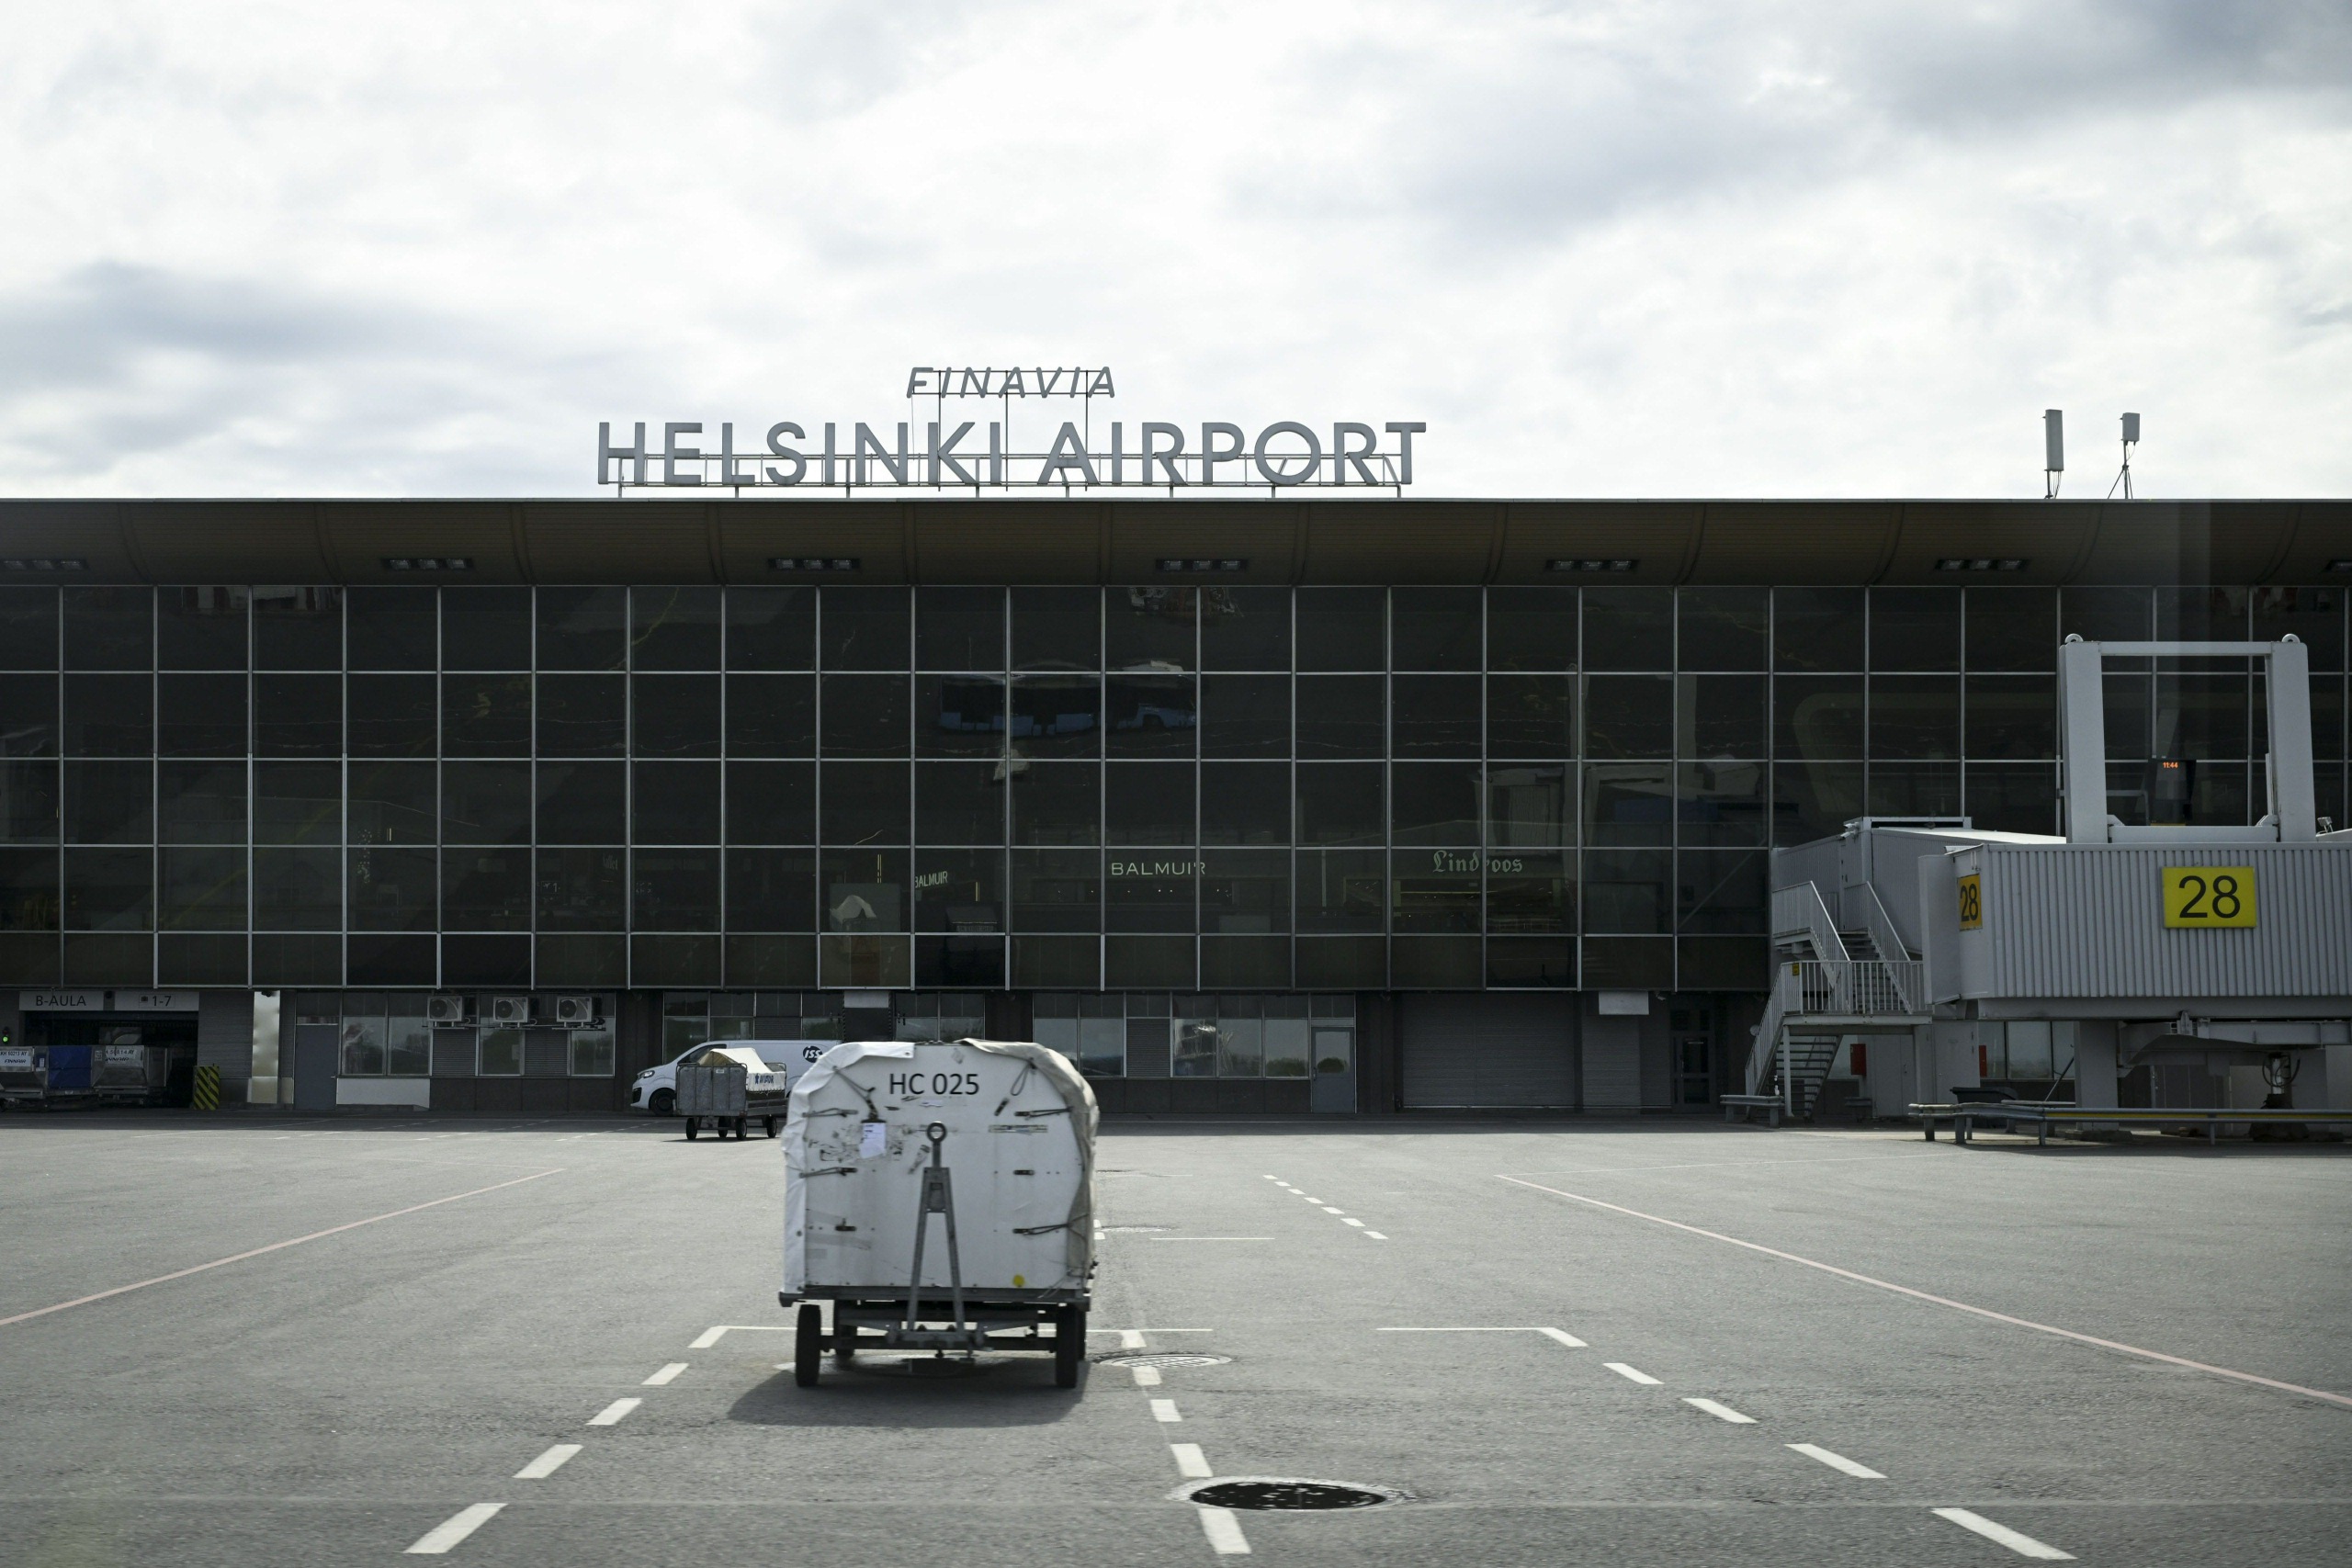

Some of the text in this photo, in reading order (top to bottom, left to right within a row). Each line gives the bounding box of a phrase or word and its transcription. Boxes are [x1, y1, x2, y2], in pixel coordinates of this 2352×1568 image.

[906, 367, 1115, 399] FINAVIA
[598, 421, 1427, 486] HELSINKI AIRPORT
[1960, 883, 1979, 922] 28
[2178, 874, 2241, 919] 28
[36, 995, 86, 1007] B-AULA
[153, 995, 172, 1007] 1-7
[889, 1073, 979, 1095] HC 025
